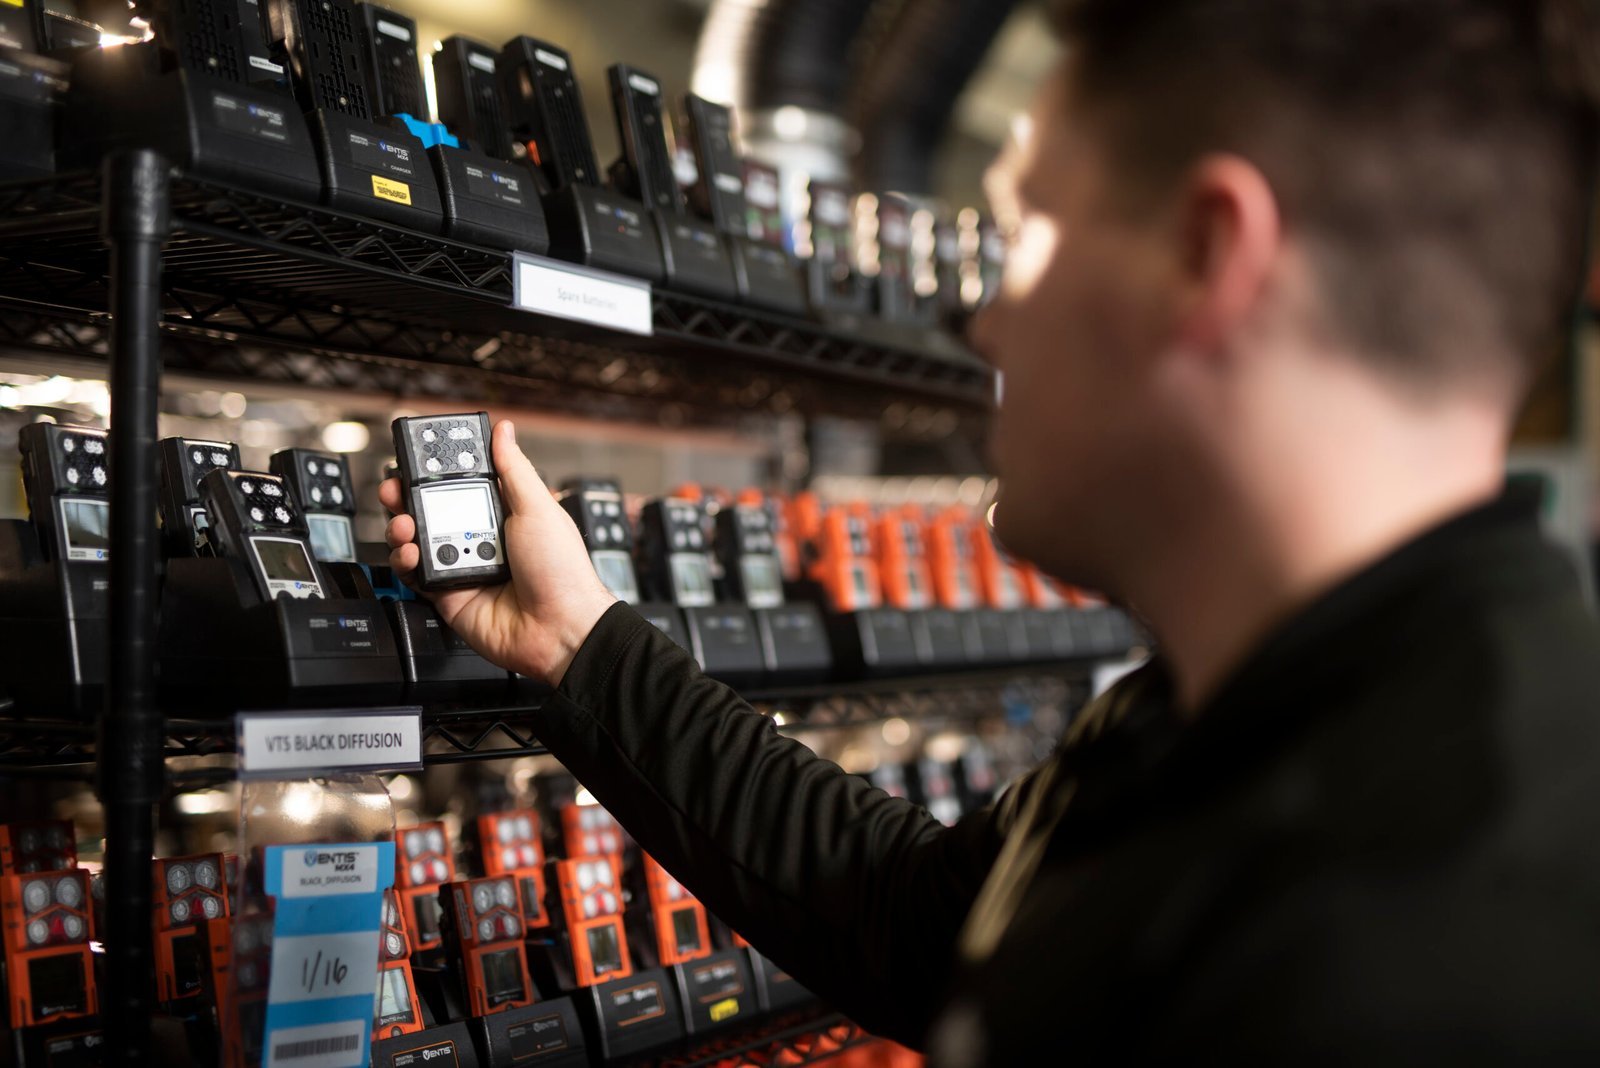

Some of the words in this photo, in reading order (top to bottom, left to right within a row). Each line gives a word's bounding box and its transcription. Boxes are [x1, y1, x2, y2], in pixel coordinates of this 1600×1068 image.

[378, 140, 409, 156] VENTIS
[464, 532, 496, 540] VENTIS
[339, 617, 367, 628] VENTIS
[265, 735, 291, 752] VTS
[295, 734, 335, 751] BLACK
[337, 732, 402, 749] DIFFUSION
[304, 850, 356, 868] VENTIS
[334, 863, 354, 872] MX4
[302, 950, 348, 993] 1/16
[422, 1046, 451, 1060] VENTIS
